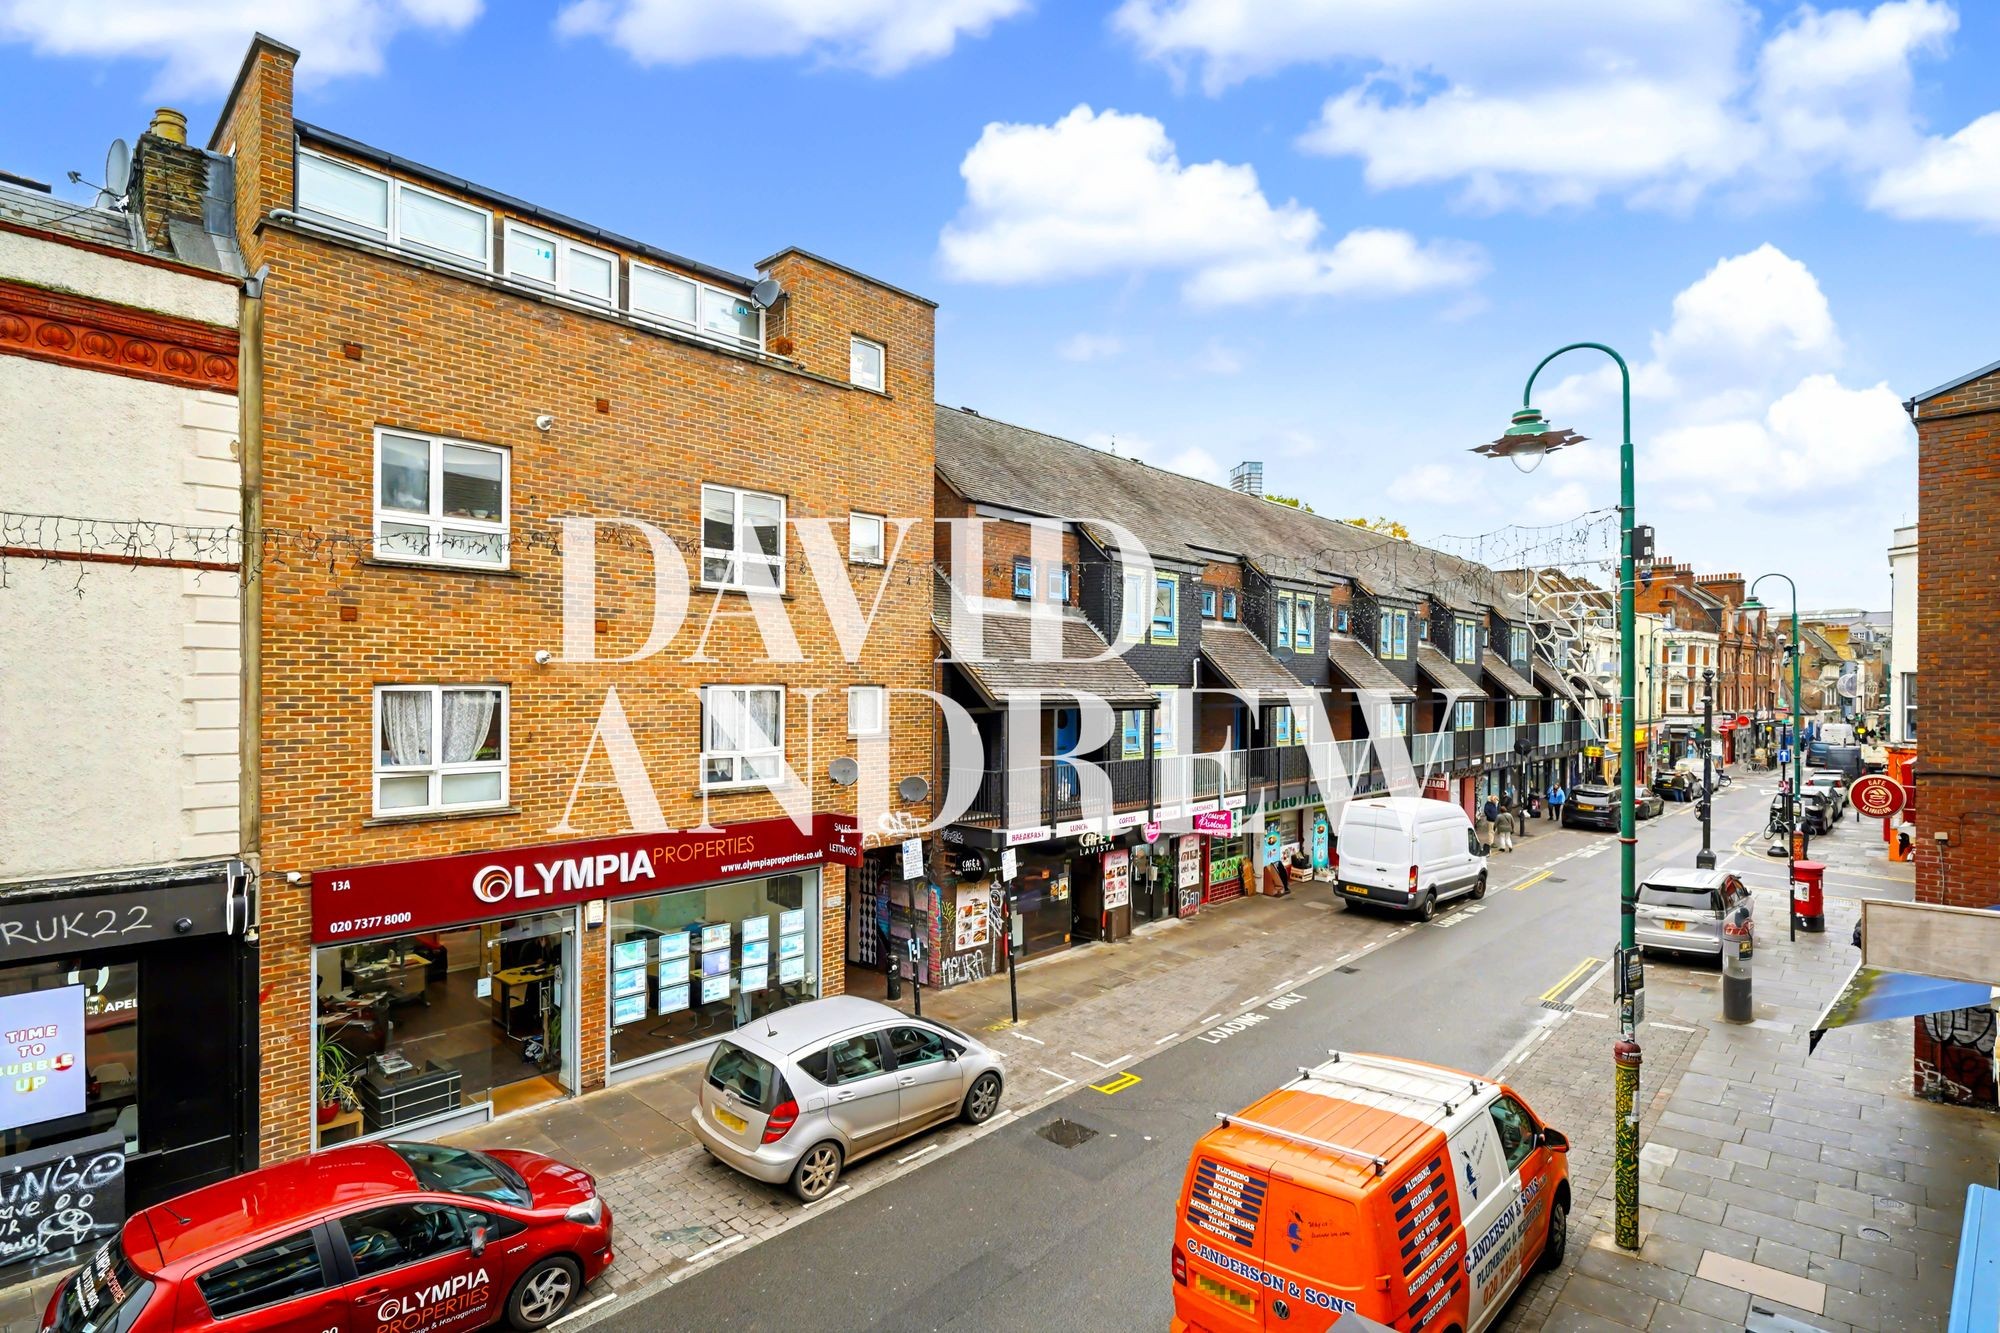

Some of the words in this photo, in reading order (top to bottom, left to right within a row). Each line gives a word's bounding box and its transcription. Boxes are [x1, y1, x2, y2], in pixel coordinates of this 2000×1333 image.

[834, 822, 852, 834] SALES
[1011, 831, 1044, 842] BREAKFAST
[653, 835, 755, 865] PROPERTIES
[720, 848, 824, 873] www.olympiaproperties.co.uk
[829, 843, 857, 857] LETTINGS
[331, 879, 351, 892] 13A
[472, 849, 655, 903] OLYMPIA
[330, 920, 352, 934] 020
[354, 915, 382, 930] 7377
[384, 911, 412, 926] 8000
[1197, 1012, 1270, 1044] LOADING
[1266, 991, 1308, 1010] ONLY
[5, 1024, 58, 1043] TIME
[18, 1043, 46, 1058] TO
[15, 1076, 47, 1092] UP
[1222, 1194, 1243, 1208] WORK
[1514, 1200, 1522, 1217] &
[1520, 1175, 1541, 1209] SONS
[1476, 1240, 1512, 1290] PLUMBING
[377, 1268, 490, 1321] OLYMPIA
[1288, 1282, 1301, 1299] &
[1304, 1287, 1357, 1316] SONS
[439, 1303, 487, 1326] Management
